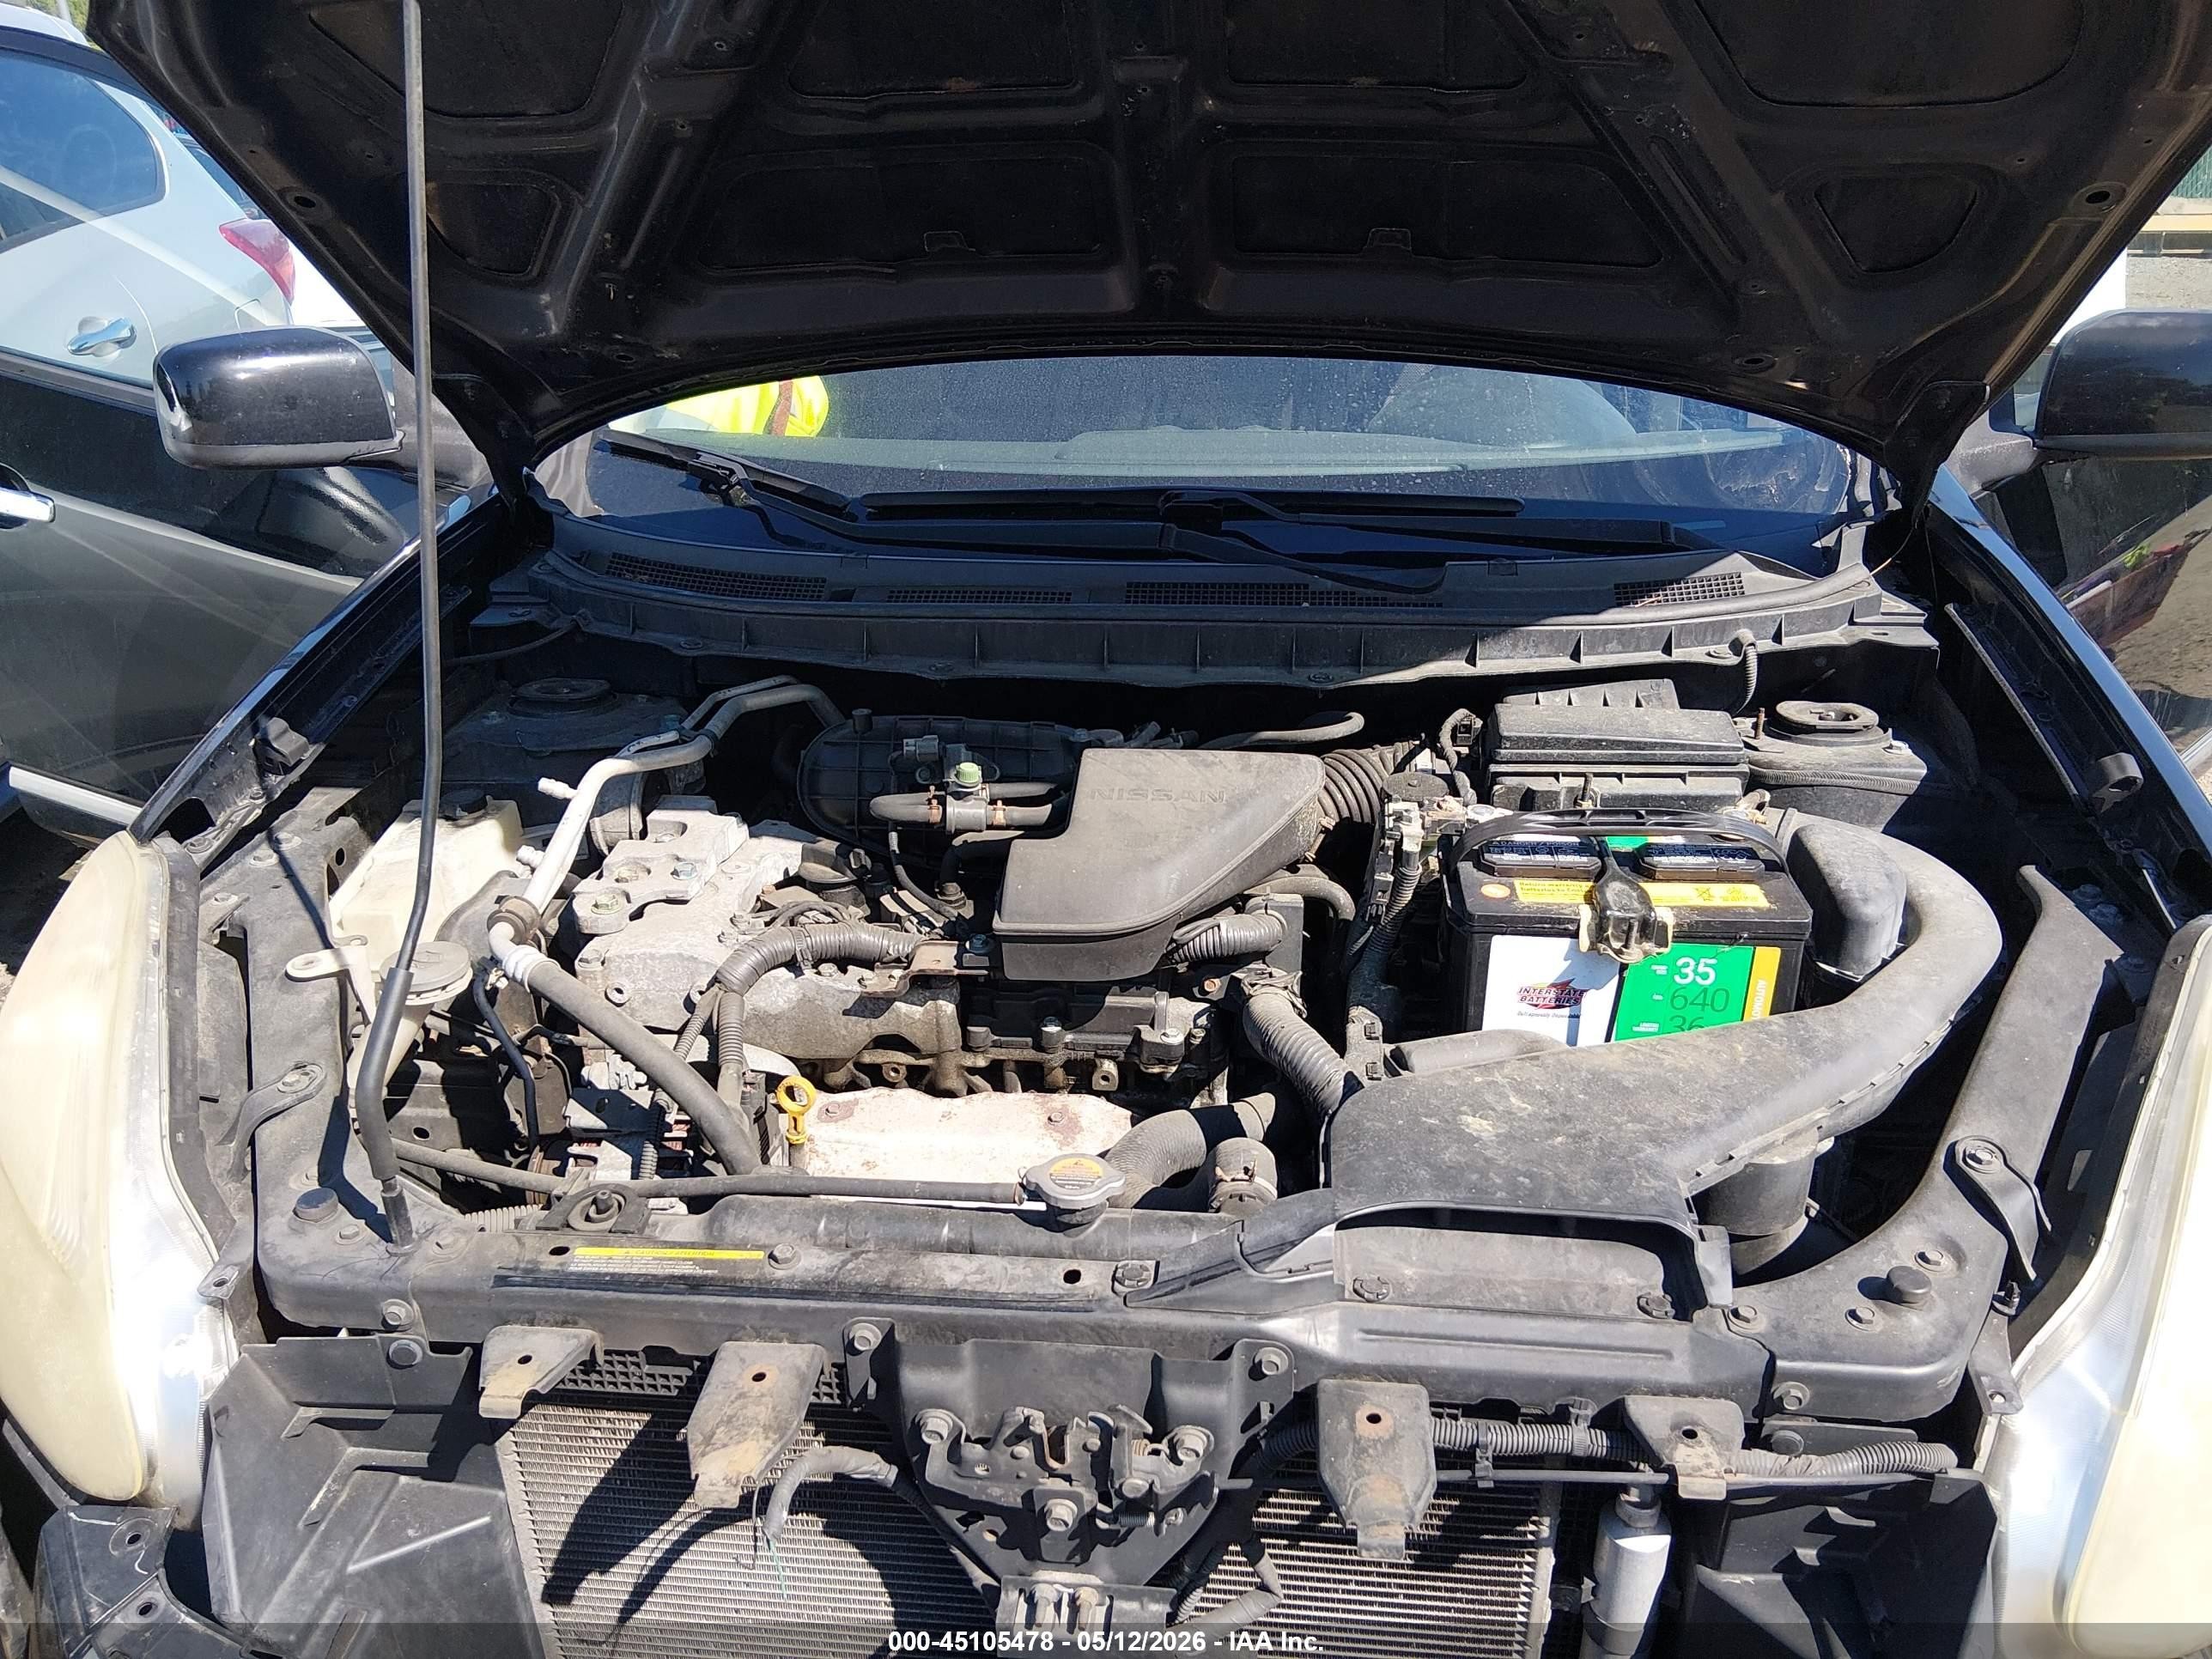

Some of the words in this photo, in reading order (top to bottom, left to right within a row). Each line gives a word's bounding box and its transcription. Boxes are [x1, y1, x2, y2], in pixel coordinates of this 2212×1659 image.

[1089, 787, 1227, 804] NISSAN
[1674, 957, 1717, 986] 35
[1518, 987, 1586, 997] INTERSTATE
[1519, 996, 1580, 1005] BATTERIES
[1669, 987, 1730, 1012] 640
